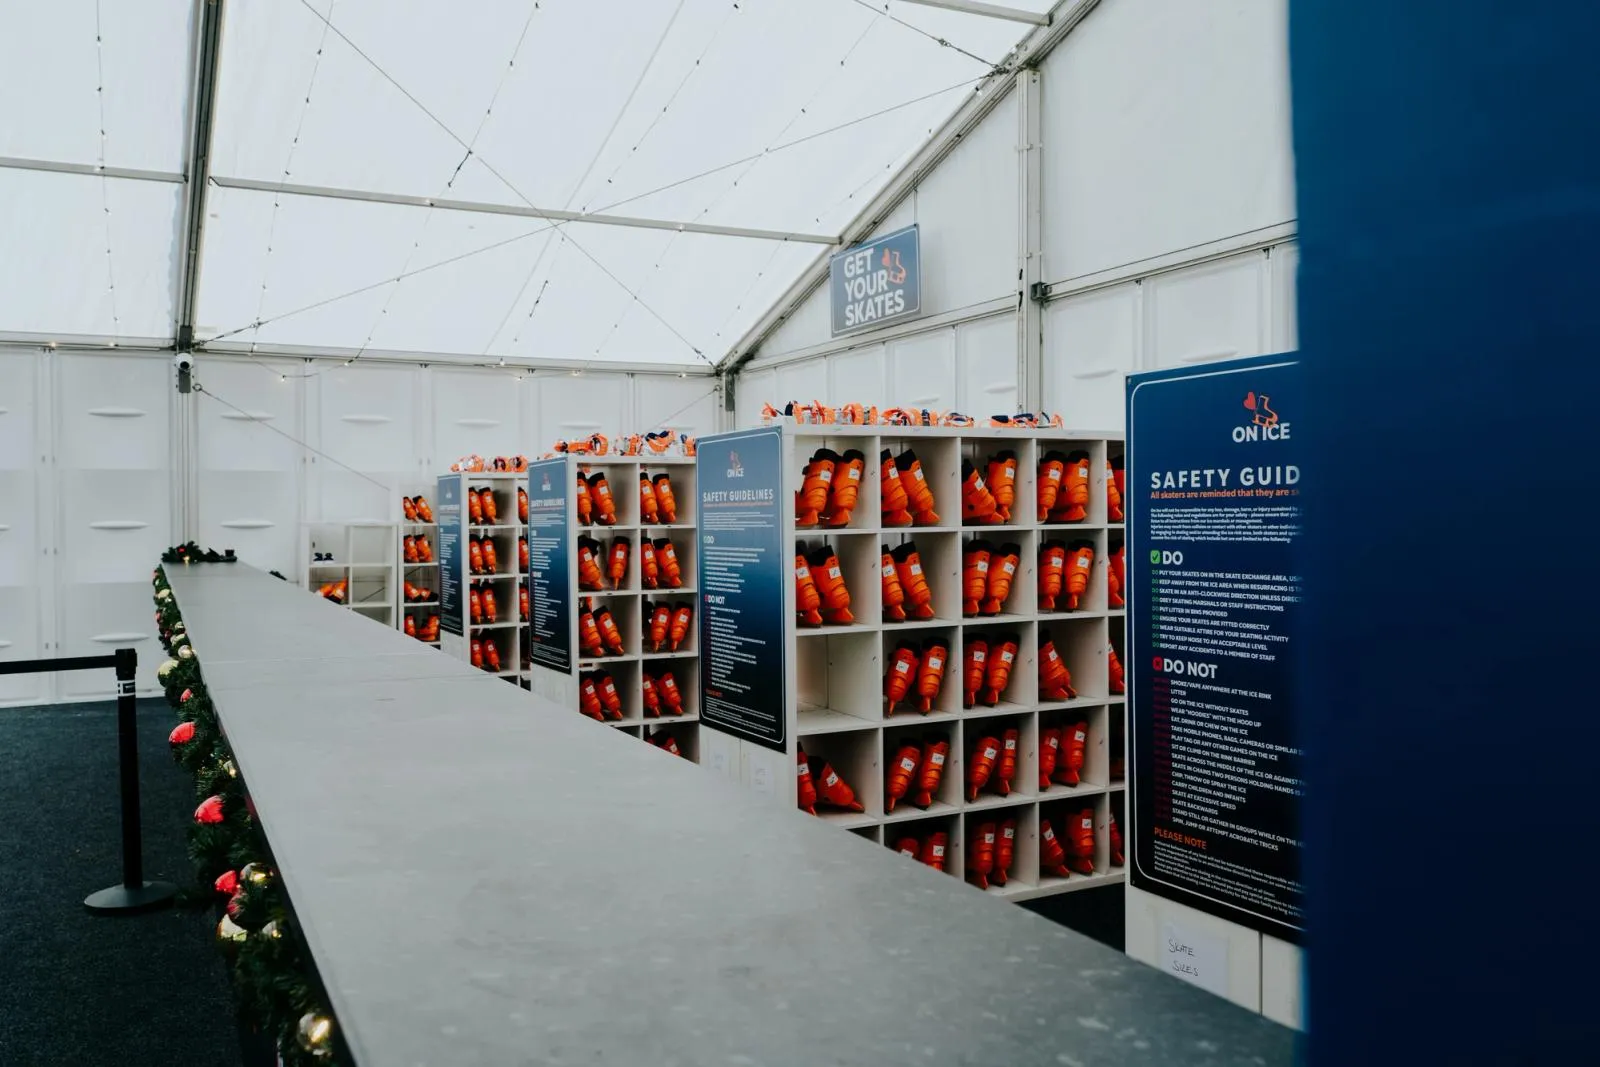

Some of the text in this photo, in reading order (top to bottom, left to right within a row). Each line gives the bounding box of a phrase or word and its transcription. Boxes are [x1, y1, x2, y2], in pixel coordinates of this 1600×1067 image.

[844, 248, 874, 278] GET
[844, 269, 888, 302] YOUR
[845, 289, 905, 326] SKATES
[1232, 422, 1290, 443] ON ICE
[727, 469, 736, 478] ON
[1151, 468, 1230, 489] SAFETY
[703, 489, 774, 502] SAFETY GUIDELINES
[1150, 491, 1160, 499] All
[1186, 490, 1197, 498] are
[1199, 489, 1235, 497] reminded
[1237, 488, 1253, 496] that
[1255, 488, 1274, 497] they
[1275, 487, 1288, 495] are
[1162, 550, 1183, 565] DO
[708, 596, 725, 605] DO NOT
[1244, 603, 1283, 611] INSTRUCTIONS
[1238, 622, 1269, 630] CORRECTLY
[1218, 640, 1250, 648] ACCEPTABLE
[1240, 632, 1262, 640] SKATING
[1263, 634, 1288, 642] ACTIVITY
[1189, 646, 1215, 654] ACCIDENTS
[1228, 650, 1250, 658] MEMBER
[1163, 658, 1217, 679] DO NOT
[1170, 679, 1200, 689] SMOKE/VAPE
[1201, 684, 1230, 693] ANYWHERE
[1258, 692, 1271, 700] RINK
[1170, 688, 1186, 696] LITTER
[1205, 703, 1228, 712] WITHOUT
[1229, 707, 1248, 715] SKATES
[1204, 722, 1219, 730] CHEW
[1236, 718, 1252, 726] HOOD
[1183, 727, 1200, 736] MOBILE
[1201, 731, 1222, 740] PHONES,
[1239, 738, 1264, 748] CAMERAS
[1274, 745, 1297, 754] SIMILAR
[1186, 746, 1200, 754] CLIMB
[1233, 756, 1255, 766] BARRIER
[1212, 742, 1228, 751] OTHER
[1229, 746, 1247, 755] GAMES
[1258, 751, 1267, 759] THE
[1171, 752, 1185, 760] SKATE
[1186, 756, 1205, 765] ACROSS
[1217, 762, 1235, 771] MIDDLE
[1273, 775, 1297, 785] AGAINST
[1171, 761, 1185, 770] SKATE
[1192, 766, 1210, 775] CHAINS
[1224, 774, 1247, 784] PERSONS
[1248, 779, 1273, 790] HOLDING
[1274, 785, 1293, 795] HANDS
[1184, 774, 1201, 783] THROW
[1211, 780, 1226, 789] SPRAY
[1171, 780, 1187, 788] CARRY
[1188, 784, 1212, 795] CHILDREN
[1224, 793, 1245, 803] INFANTS
[1171, 789, 1236, 810] SKATE EXCESSIVE SPEED
[1172, 798, 1217, 815] SKATE BACKWARDS
[1172, 807, 1275, 840] STAND STILL GATHER GROUPS WHILE
[1154, 826, 1206, 850] PLEASE NOTE
[1185, 820, 1278, 851] JUMP ATTEMPT ACROBATIC TRICKS
[1169, 938, 1195, 956] SKATE
